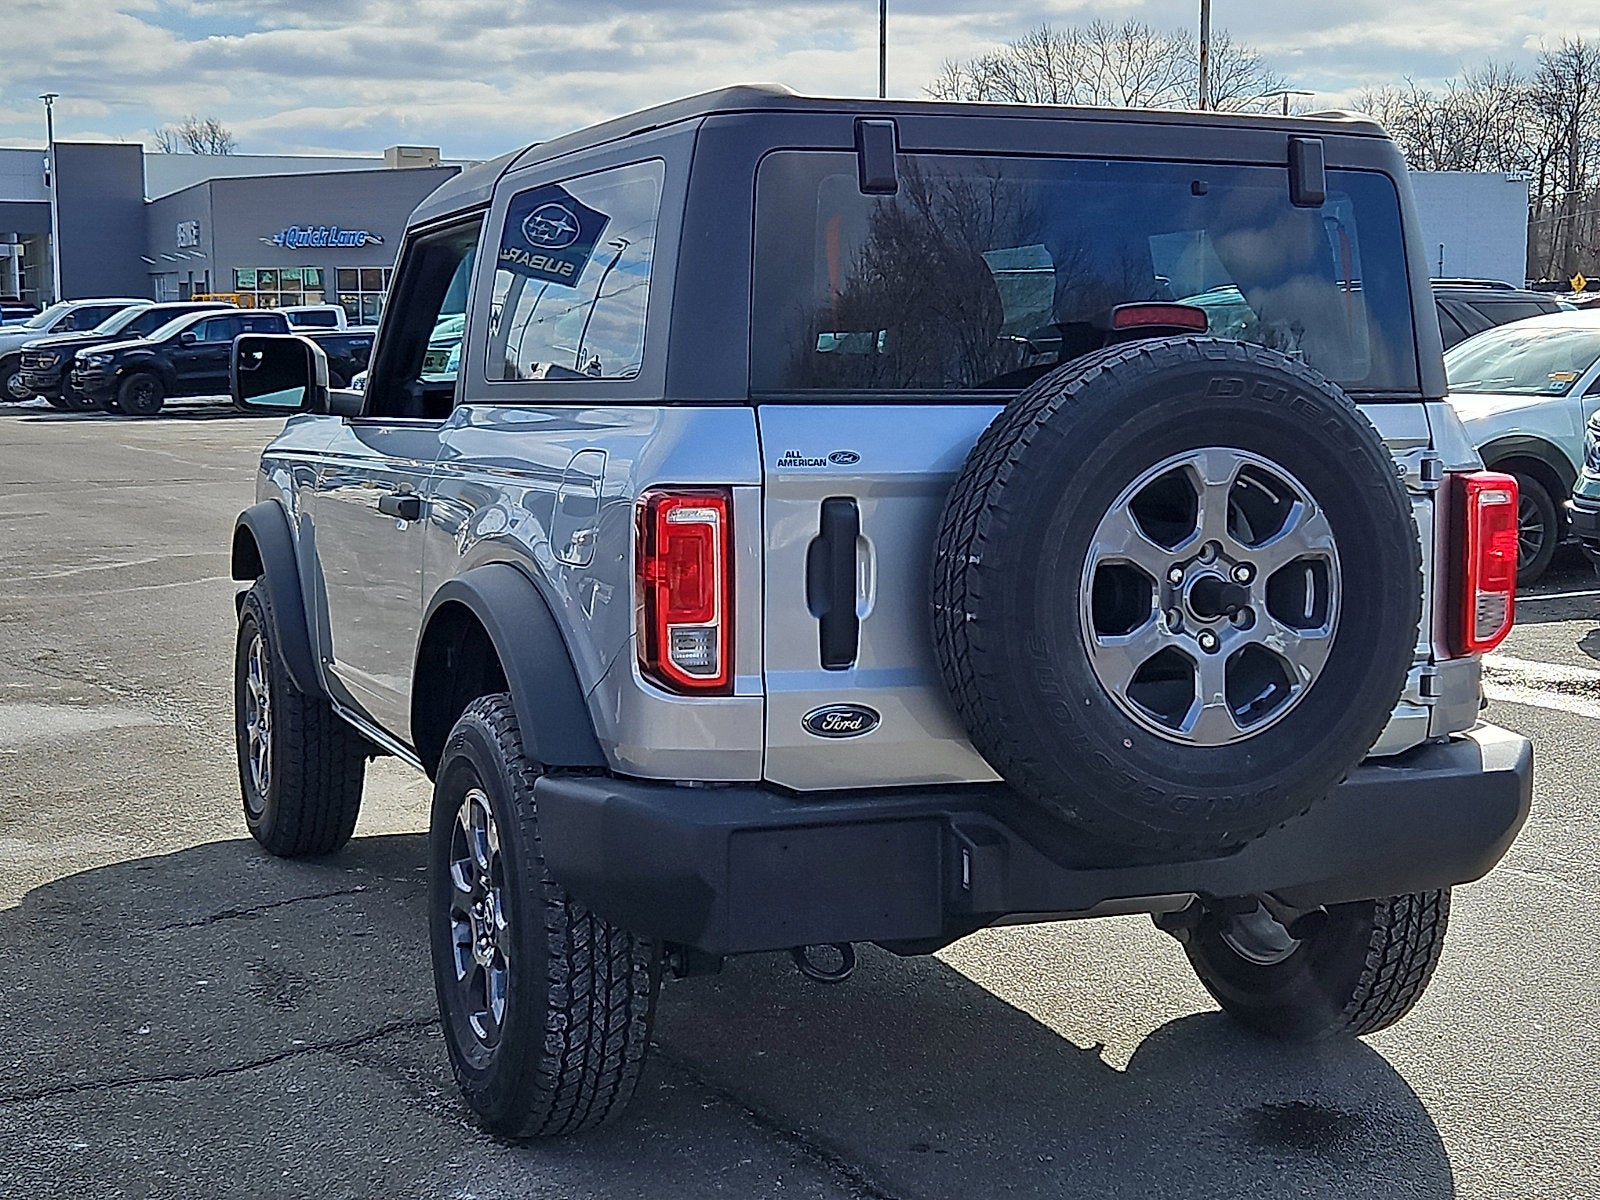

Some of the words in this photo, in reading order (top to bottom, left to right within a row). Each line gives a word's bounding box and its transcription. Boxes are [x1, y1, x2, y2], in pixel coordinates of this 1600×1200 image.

[286, 226, 329, 249] Quick
[328, 226, 368, 247] Lane
[785, 450, 802, 459] ALL
[777, 458, 827, 467] AMERICAN
[821, 712, 863, 731] Ford
